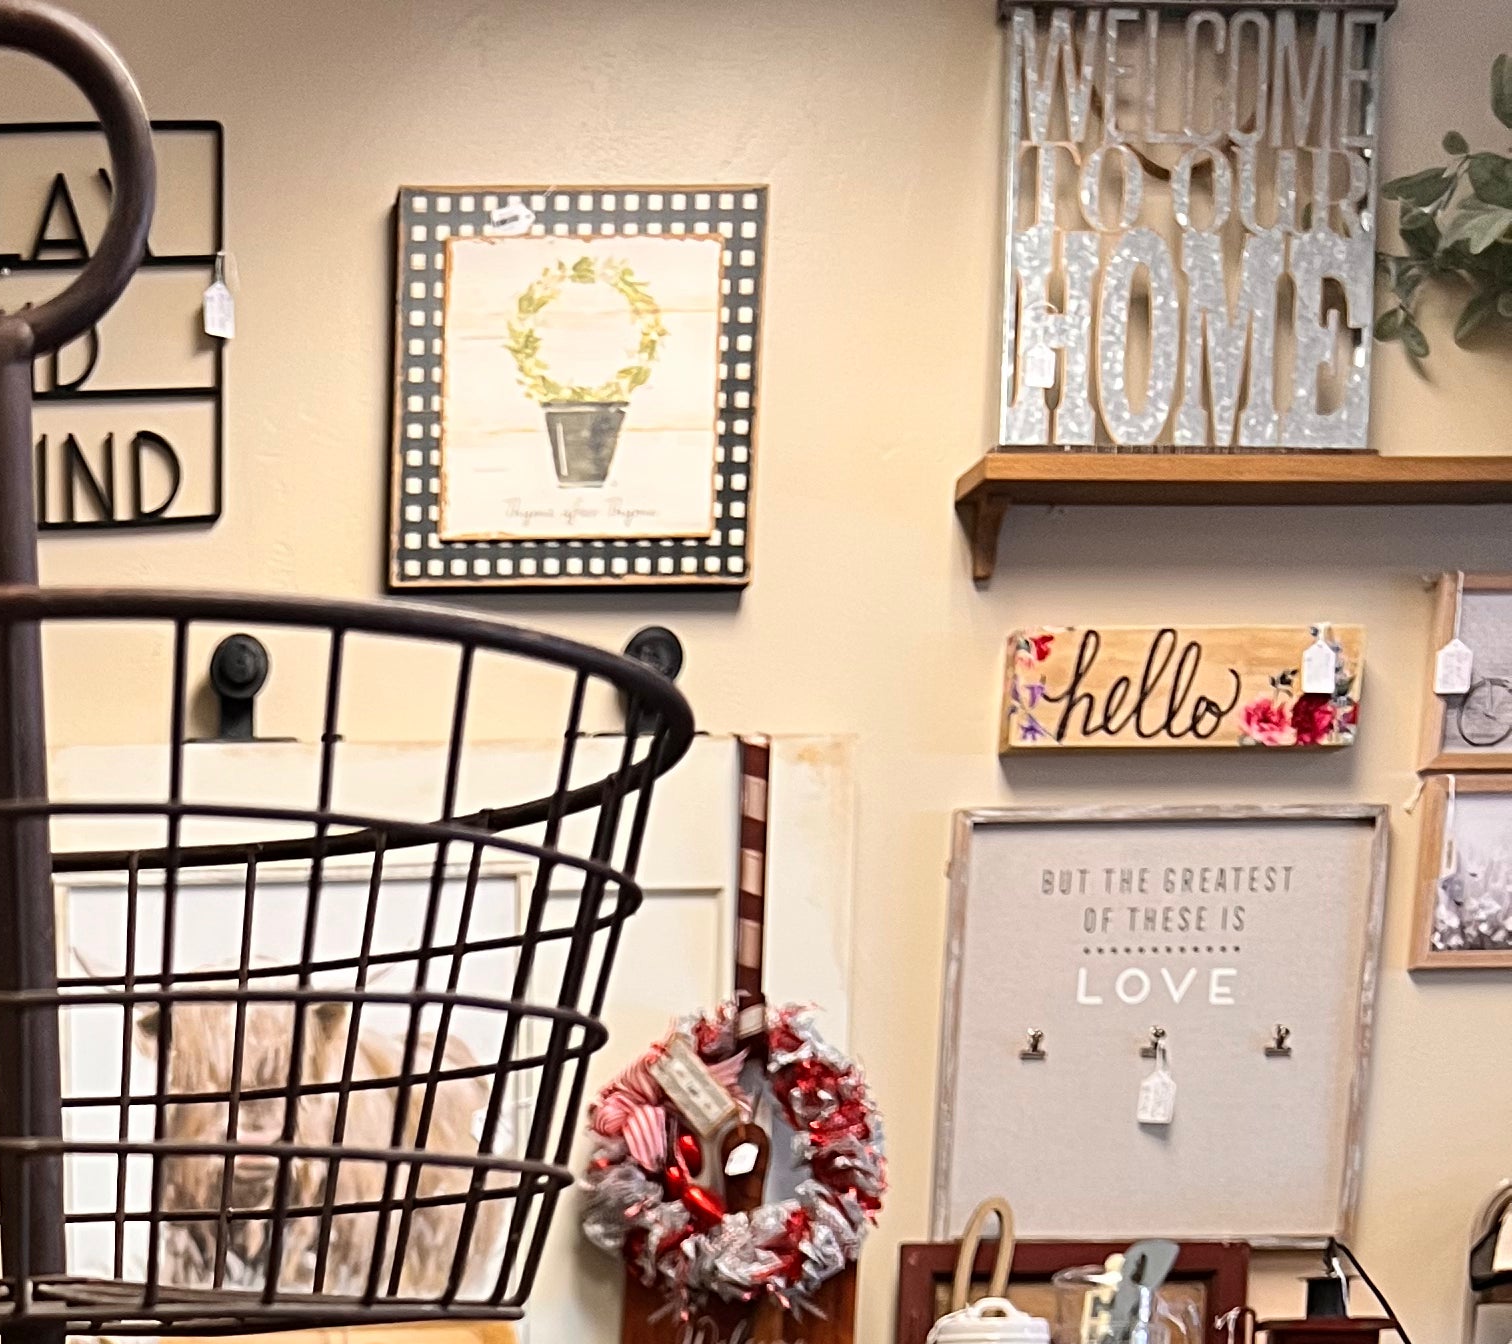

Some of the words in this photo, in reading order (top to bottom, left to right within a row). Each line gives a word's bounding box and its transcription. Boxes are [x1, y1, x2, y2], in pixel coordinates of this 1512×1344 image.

[1012, 10, 1378, 143] WELCOME
[1019, 141, 1144, 231] TO
[1171, 144, 1370, 237] OUR
[1003, 227, 1368, 445] HOME
[1042, 628, 1241, 742] hello
[1042, 868, 1091, 895] BUT
[1104, 867, 1149, 893] THE
[1163, 865, 1296, 892] GREATEST
[1084, 908, 1114, 933] OF
[1127, 906, 1207, 932] THESE
[1221, 905, 1247, 931] IS
[1076, 967, 1238, 1006] LOVE
